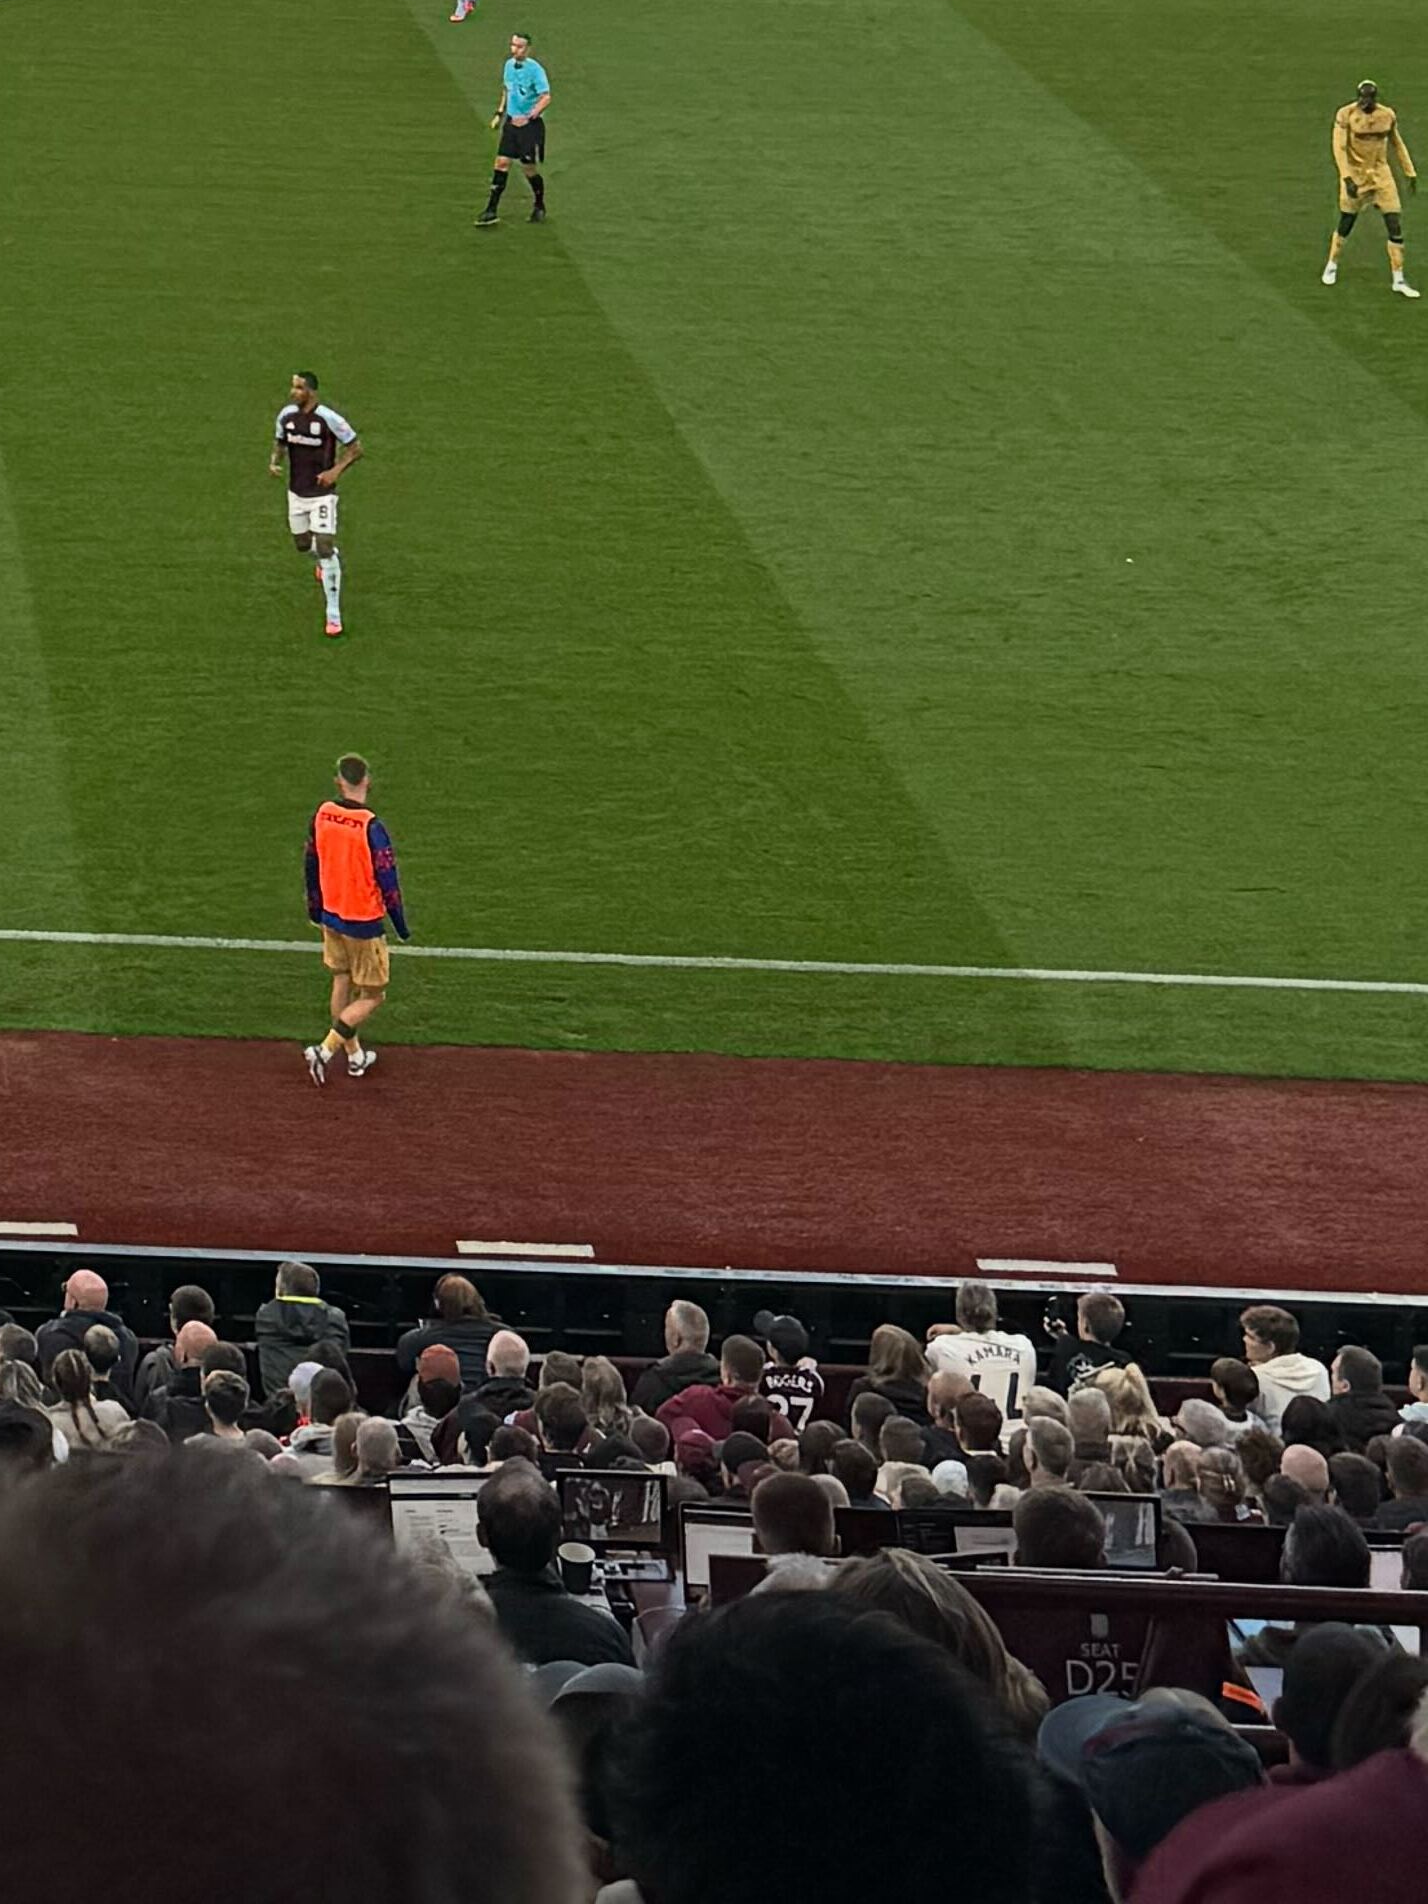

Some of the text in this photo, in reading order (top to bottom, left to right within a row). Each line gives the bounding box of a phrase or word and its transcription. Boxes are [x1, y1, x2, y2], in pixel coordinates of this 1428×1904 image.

[966, 1345, 1020, 1366] KAMARA
[1080, 1643, 1120, 1658] SEAT
[1066, 1659, 1139, 1696] D25
